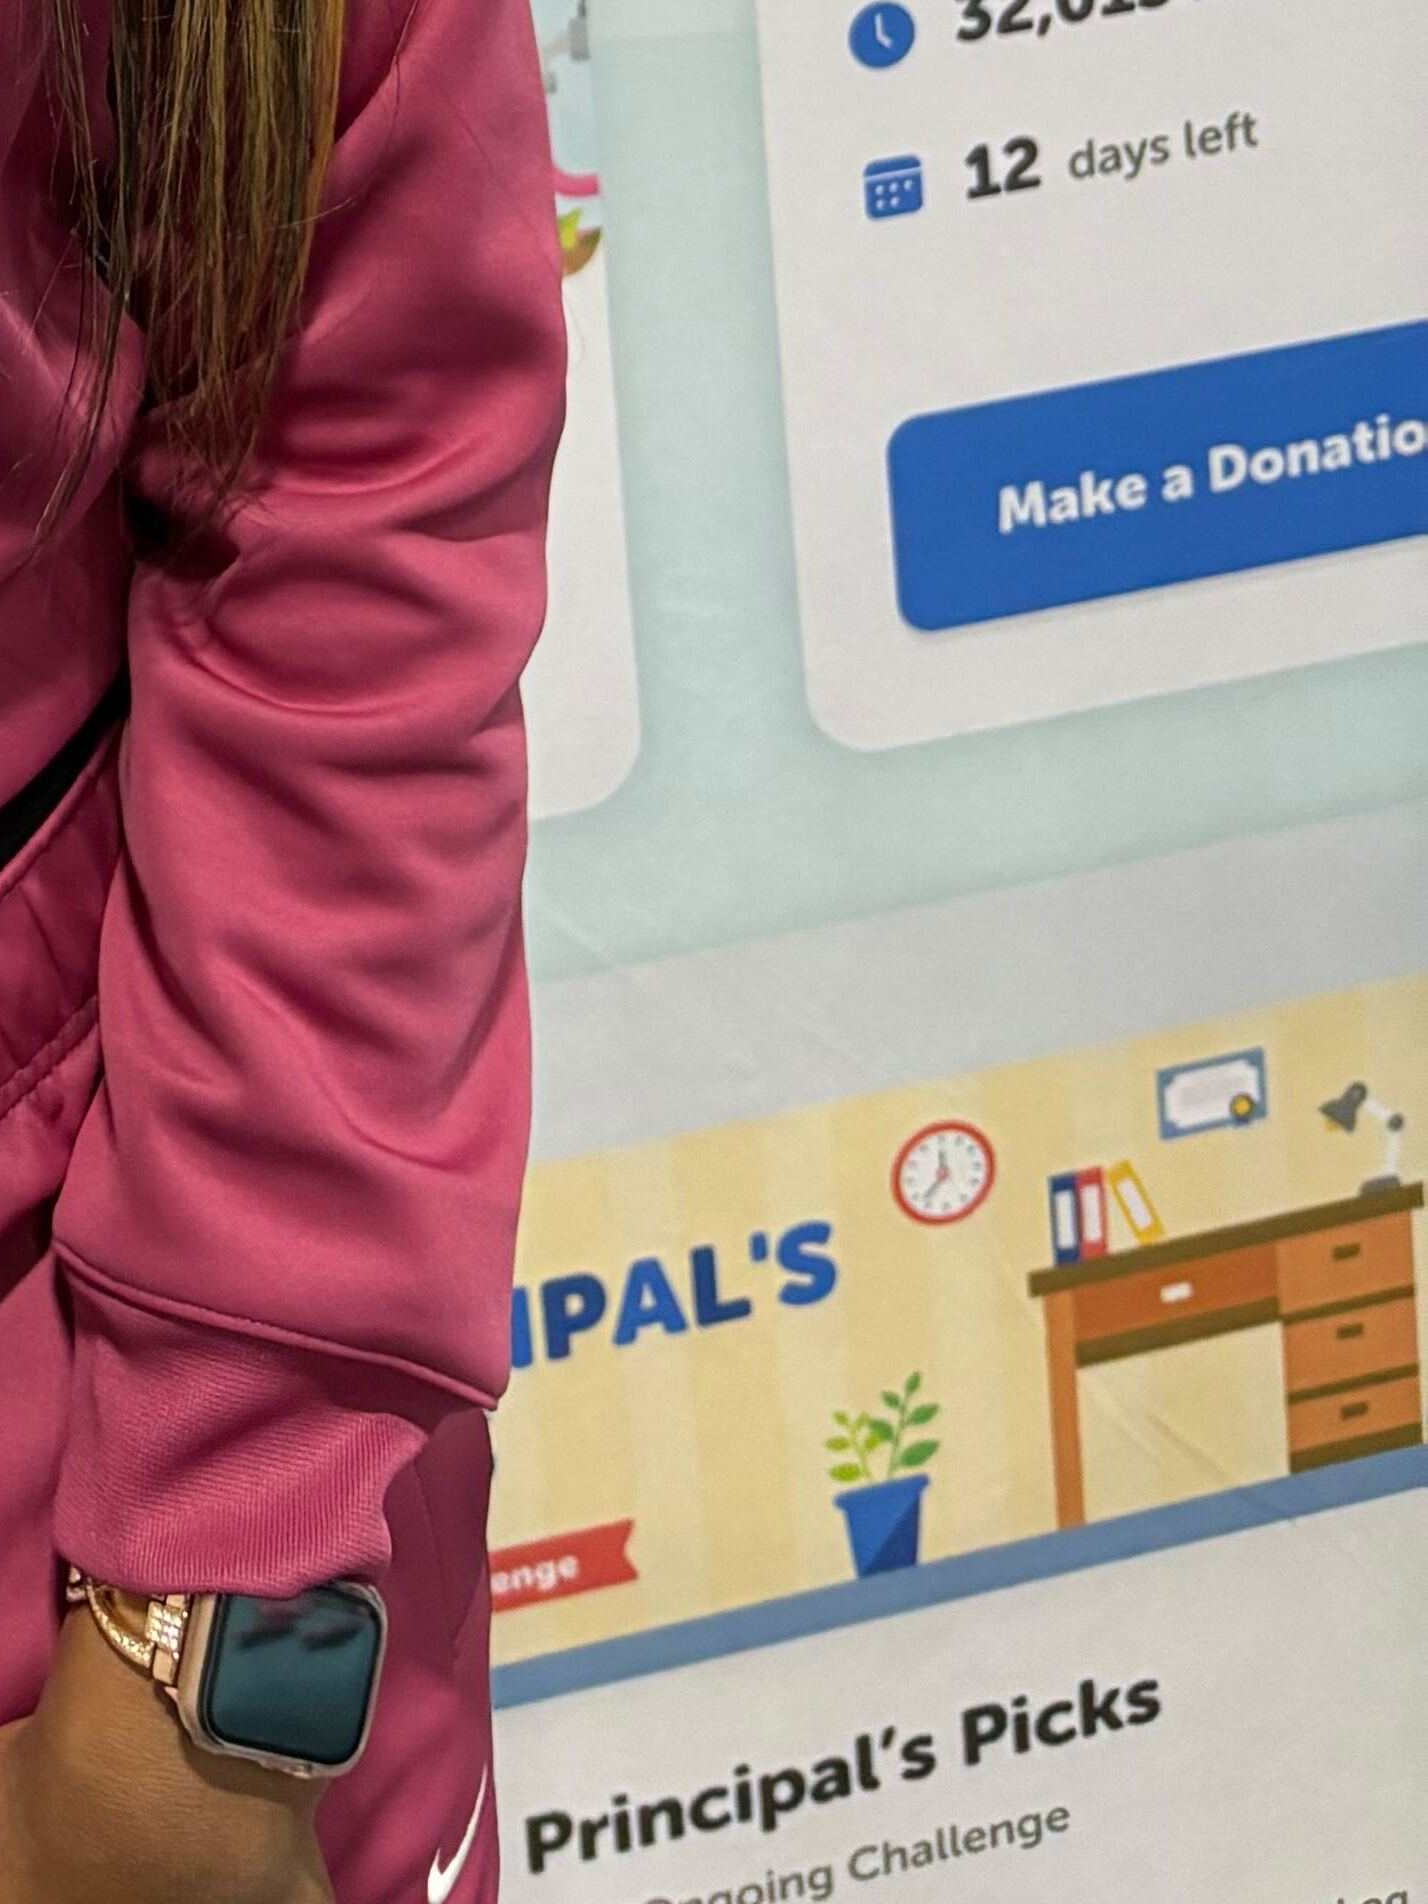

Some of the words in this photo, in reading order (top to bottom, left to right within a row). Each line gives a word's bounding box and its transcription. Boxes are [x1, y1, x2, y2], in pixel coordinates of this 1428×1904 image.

[964, 135, 1042, 199] 12
[1067, 132, 1170, 182] days
[1184, 111, 1259, 159] left
[997, 469, 1149, 535] Make
[1161, 464, 1195, 502] a
[1206, 413, 1428, 493] Donatio
[490, 1553, 581, 1594] enge
[524, 1726, 936, 1875] Principal's
[960, 1678, 1162, 1767] Picks
[847, 1801, 1072, 1881] Challenge
